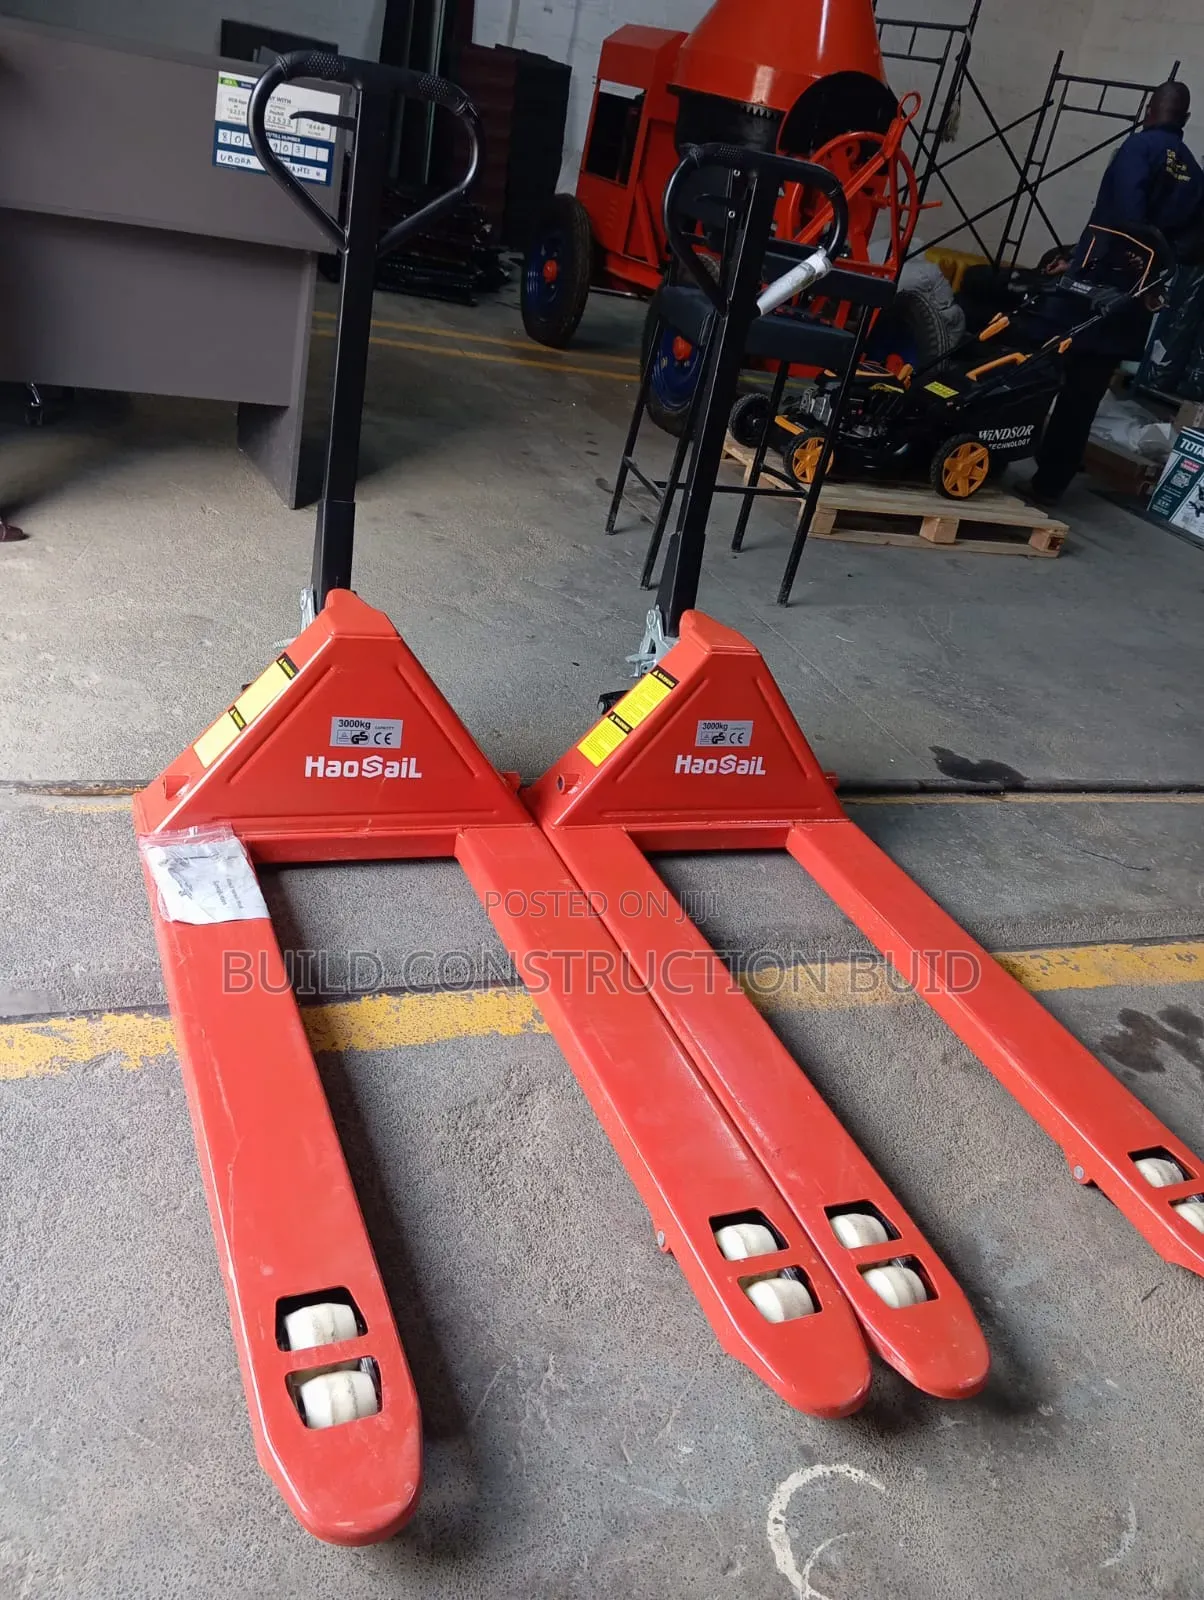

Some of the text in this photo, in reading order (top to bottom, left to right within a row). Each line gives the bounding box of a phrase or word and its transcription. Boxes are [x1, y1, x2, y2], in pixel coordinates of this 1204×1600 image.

[338, 719, 371, 730] 3000kg
[702, 722, 729, 731] 3000kg
[374, 732, 392, 745] CE
[729, 732, 744, 744] CE
